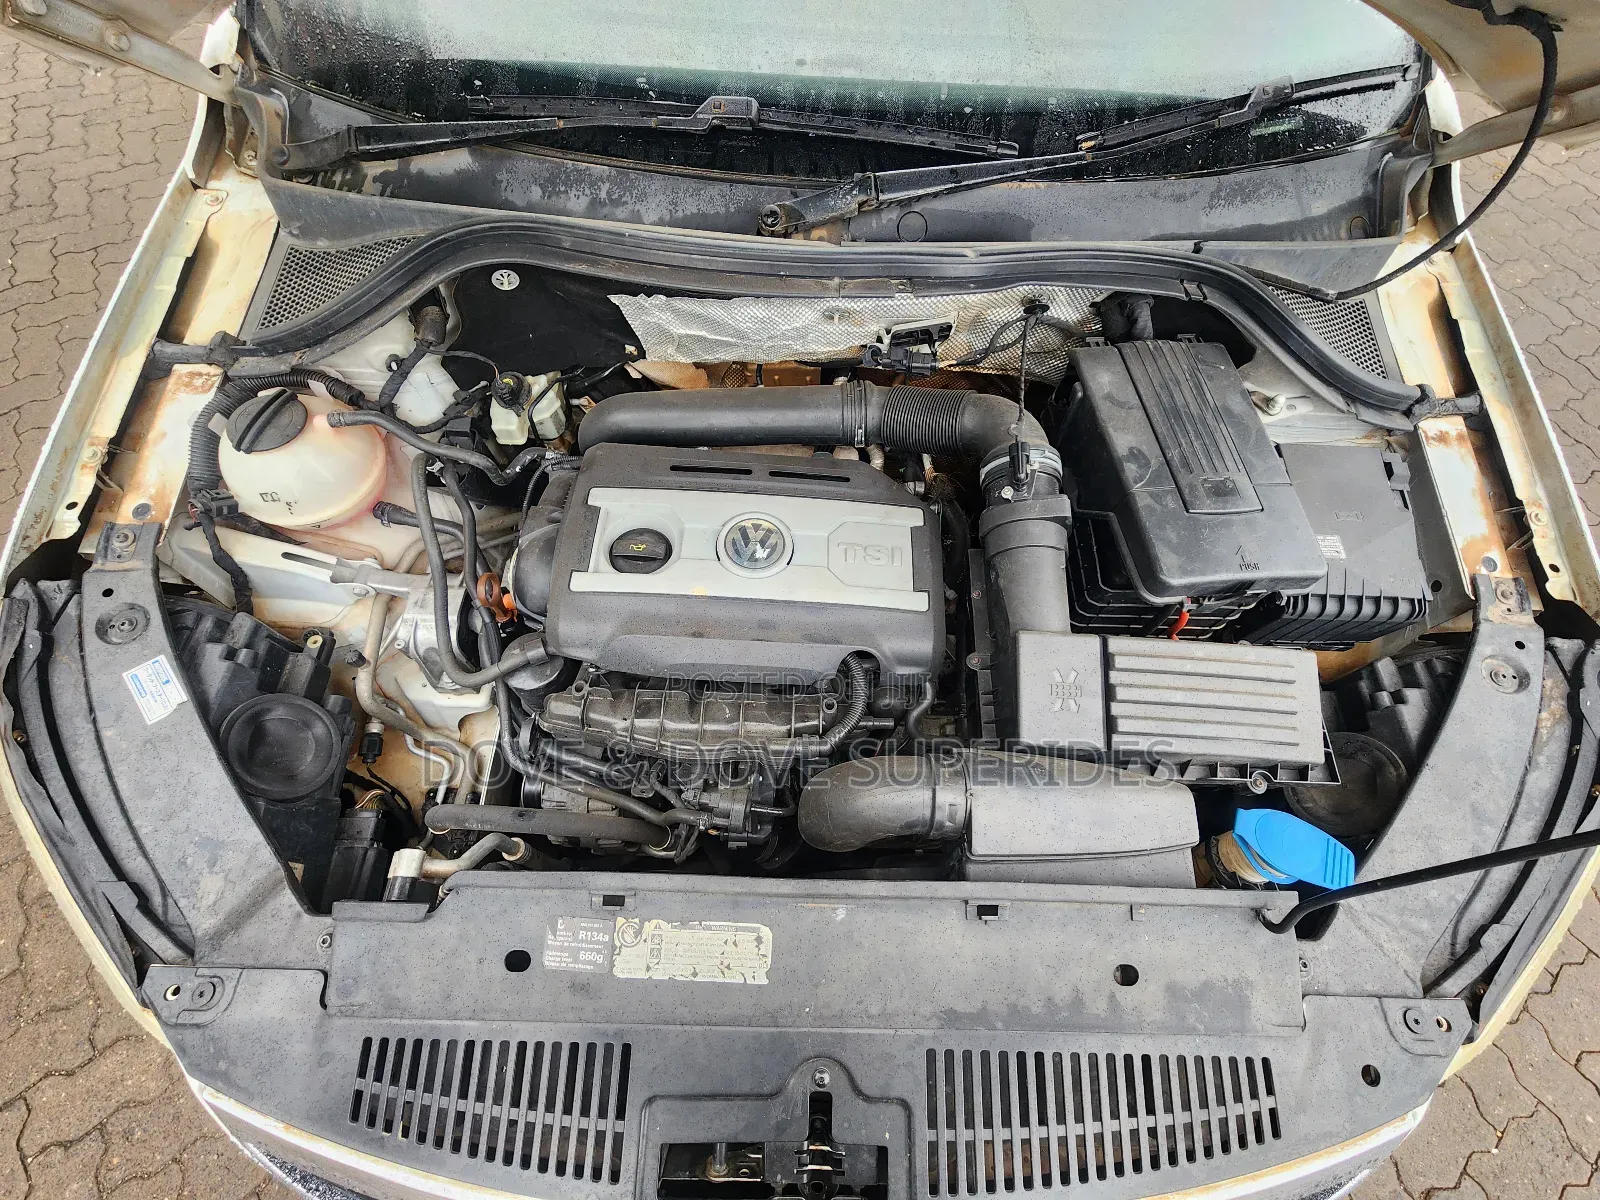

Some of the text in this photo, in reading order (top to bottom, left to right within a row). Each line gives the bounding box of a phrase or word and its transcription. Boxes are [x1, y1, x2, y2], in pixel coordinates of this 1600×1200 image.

[838, 541, 903, 568] TSI
[579, 931, 609, 942] R134a
[580, 951, 604, 964] 660g
